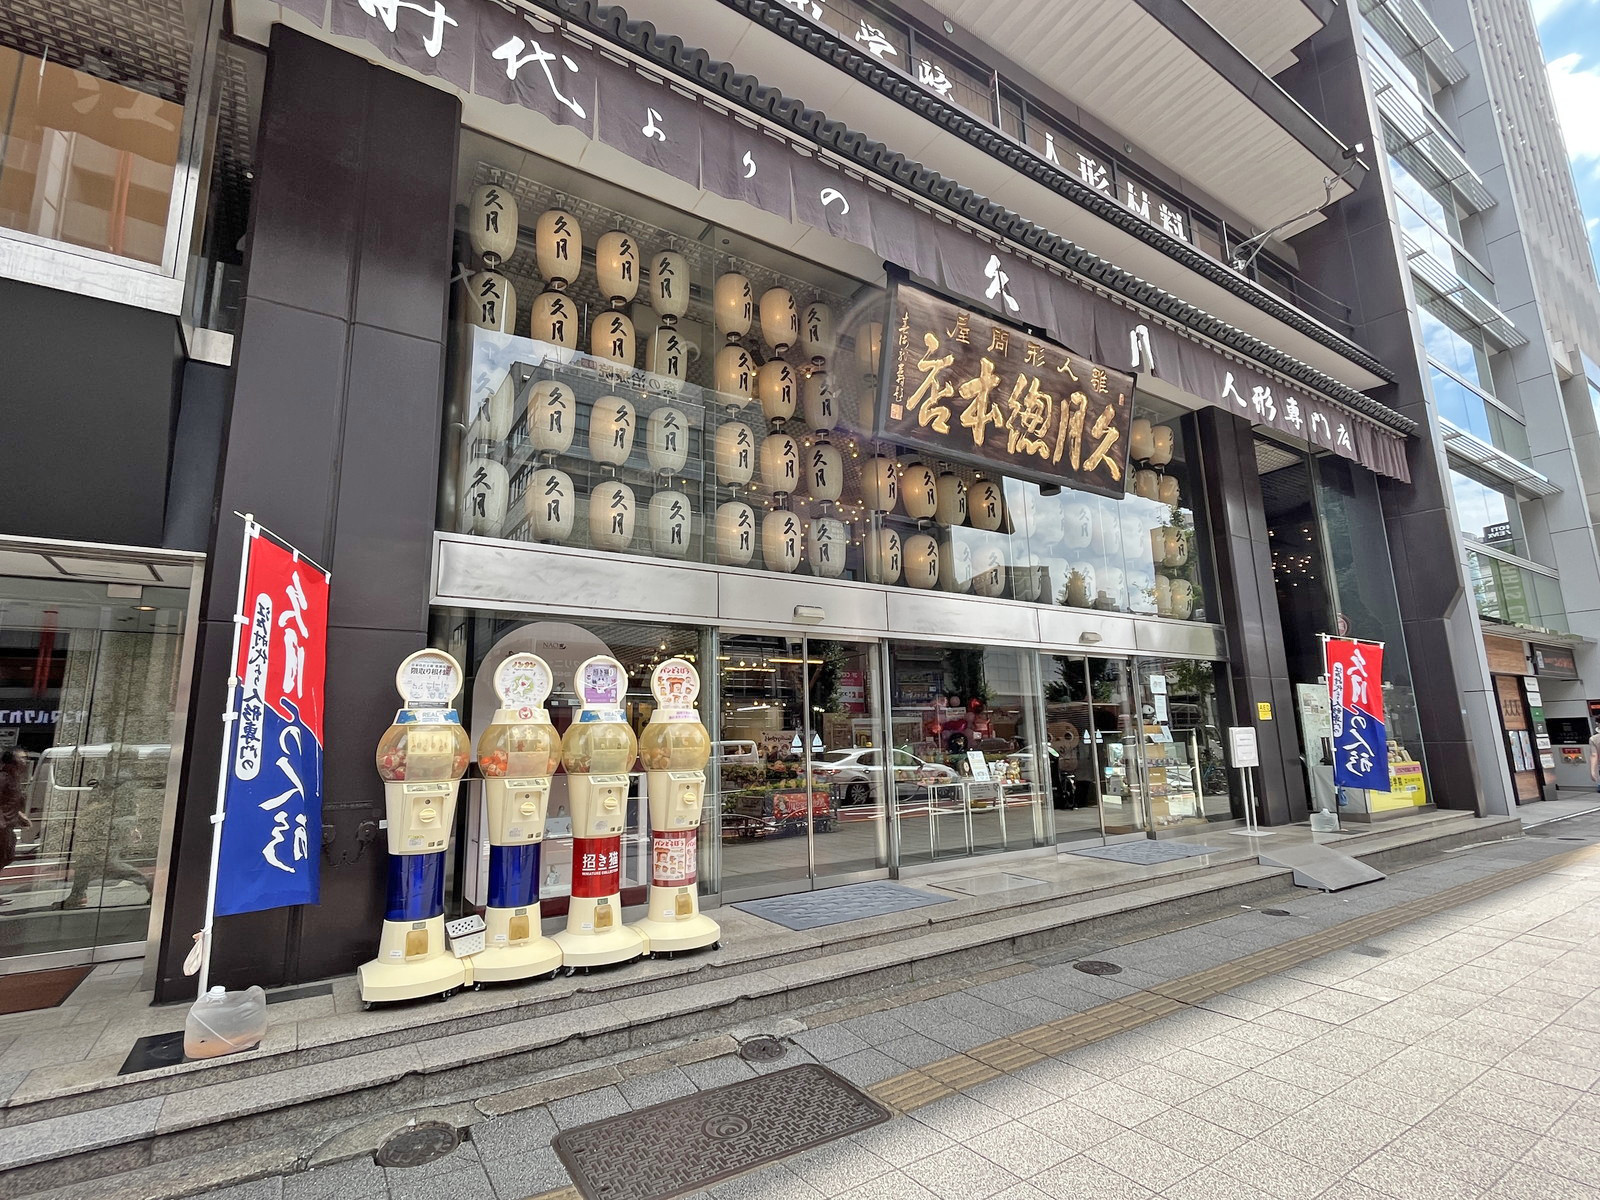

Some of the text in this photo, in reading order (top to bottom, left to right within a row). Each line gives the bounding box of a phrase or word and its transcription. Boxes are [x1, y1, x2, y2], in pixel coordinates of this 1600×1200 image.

[1045, 132, 1188, 241] 人形材料
[484, 189, 503, 233] 久月
[554, 216, 571, 261] 久月
[620, 239, 634, 282] 久月
[659, 257, 674, 298] 久月
[480, 278, 500, 324] 久月
[550, 298, 568, 342] 久月
[788, 296, 799, 333] 久月
[610, 317, 627, 358] 久月
[807, 308, 821, 343] 久月
[667, 336, 681, 376] 久月
[738, 352, 751, 391] 久月
[780, 366, 793, 404] 久月
[820, 381, 833, 417] 久月
[548, 387, 567, 433] 久月
[614, 405, 630, 449] 久月
[663, 411, 680, 452] 久月
[737, 428, 751, 469] 久月
[783, 440, 796, 479] 久月
[813, 450, 828, 488] 久月
[471, 466, 492, 518] 久月
[545, 476, 564, 523] 久月
[887, 464, 897, 498] 久月
[923, 471, 935, 505] 久月
[957, 480, 966, 514] 久月
[610, 489, 628, 535] 久月
[669, 500, 685, 545] 久月
[984, 486, 997, 518] 久月
[738, 509, 752, 551] 久月
[783, 517, 797, 558] 久月
[817, 524, 831, 563] 久月
[1175, 530, 1185, 557] 久月
[889, 535, 900, 572] 久月
[927, 541, 938, 577] 久月
[582, 851, 619, 869] 招き猫
